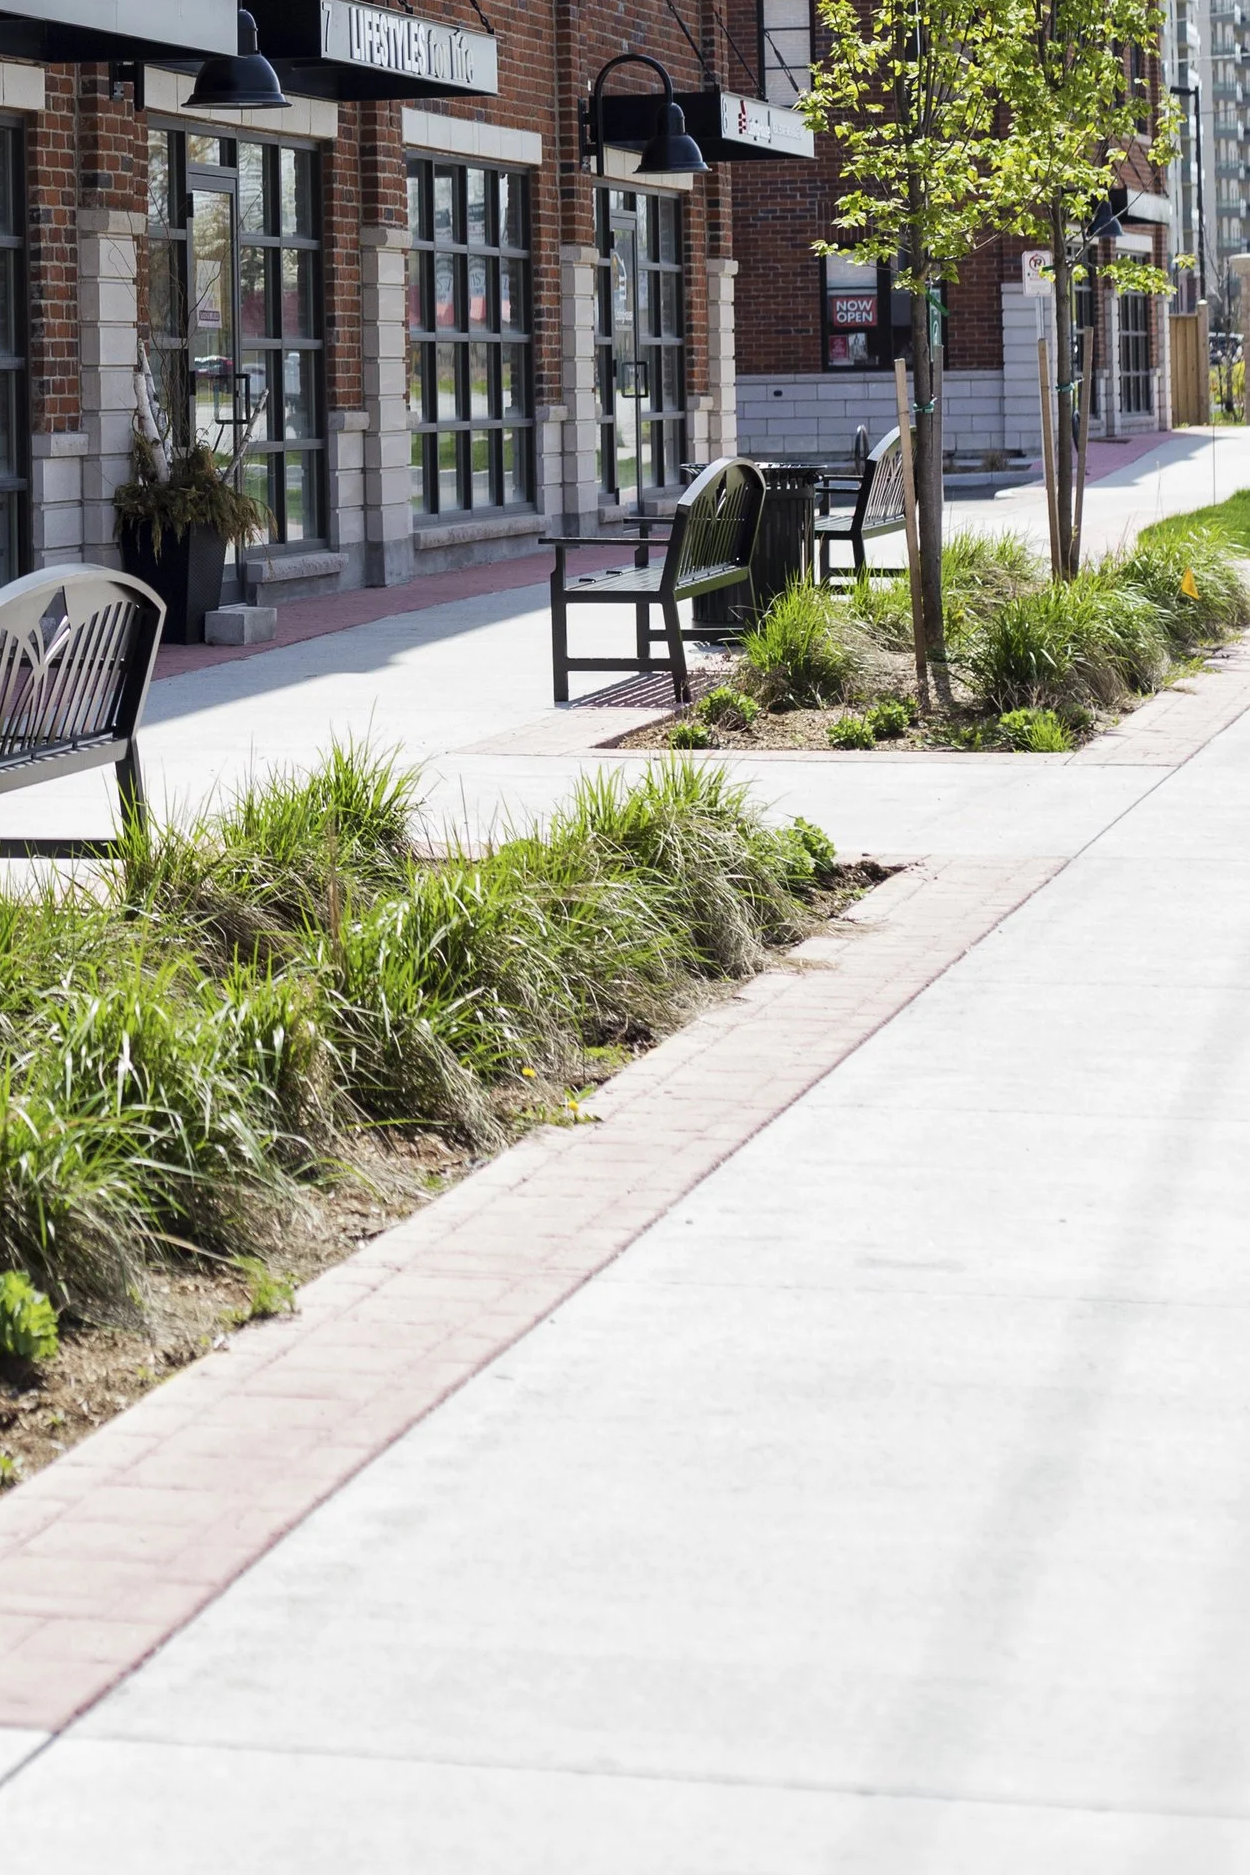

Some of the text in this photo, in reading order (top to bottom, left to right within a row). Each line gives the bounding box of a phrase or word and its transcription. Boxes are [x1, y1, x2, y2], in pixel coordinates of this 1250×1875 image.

[321, 1, 333, 53] 7
[350, 6, 429, 76] LIFESTYLES
[427, 29, 449, 79] for
[836, 300, 873, 312] NOW
[836, 311, 873, 323] OPEN
